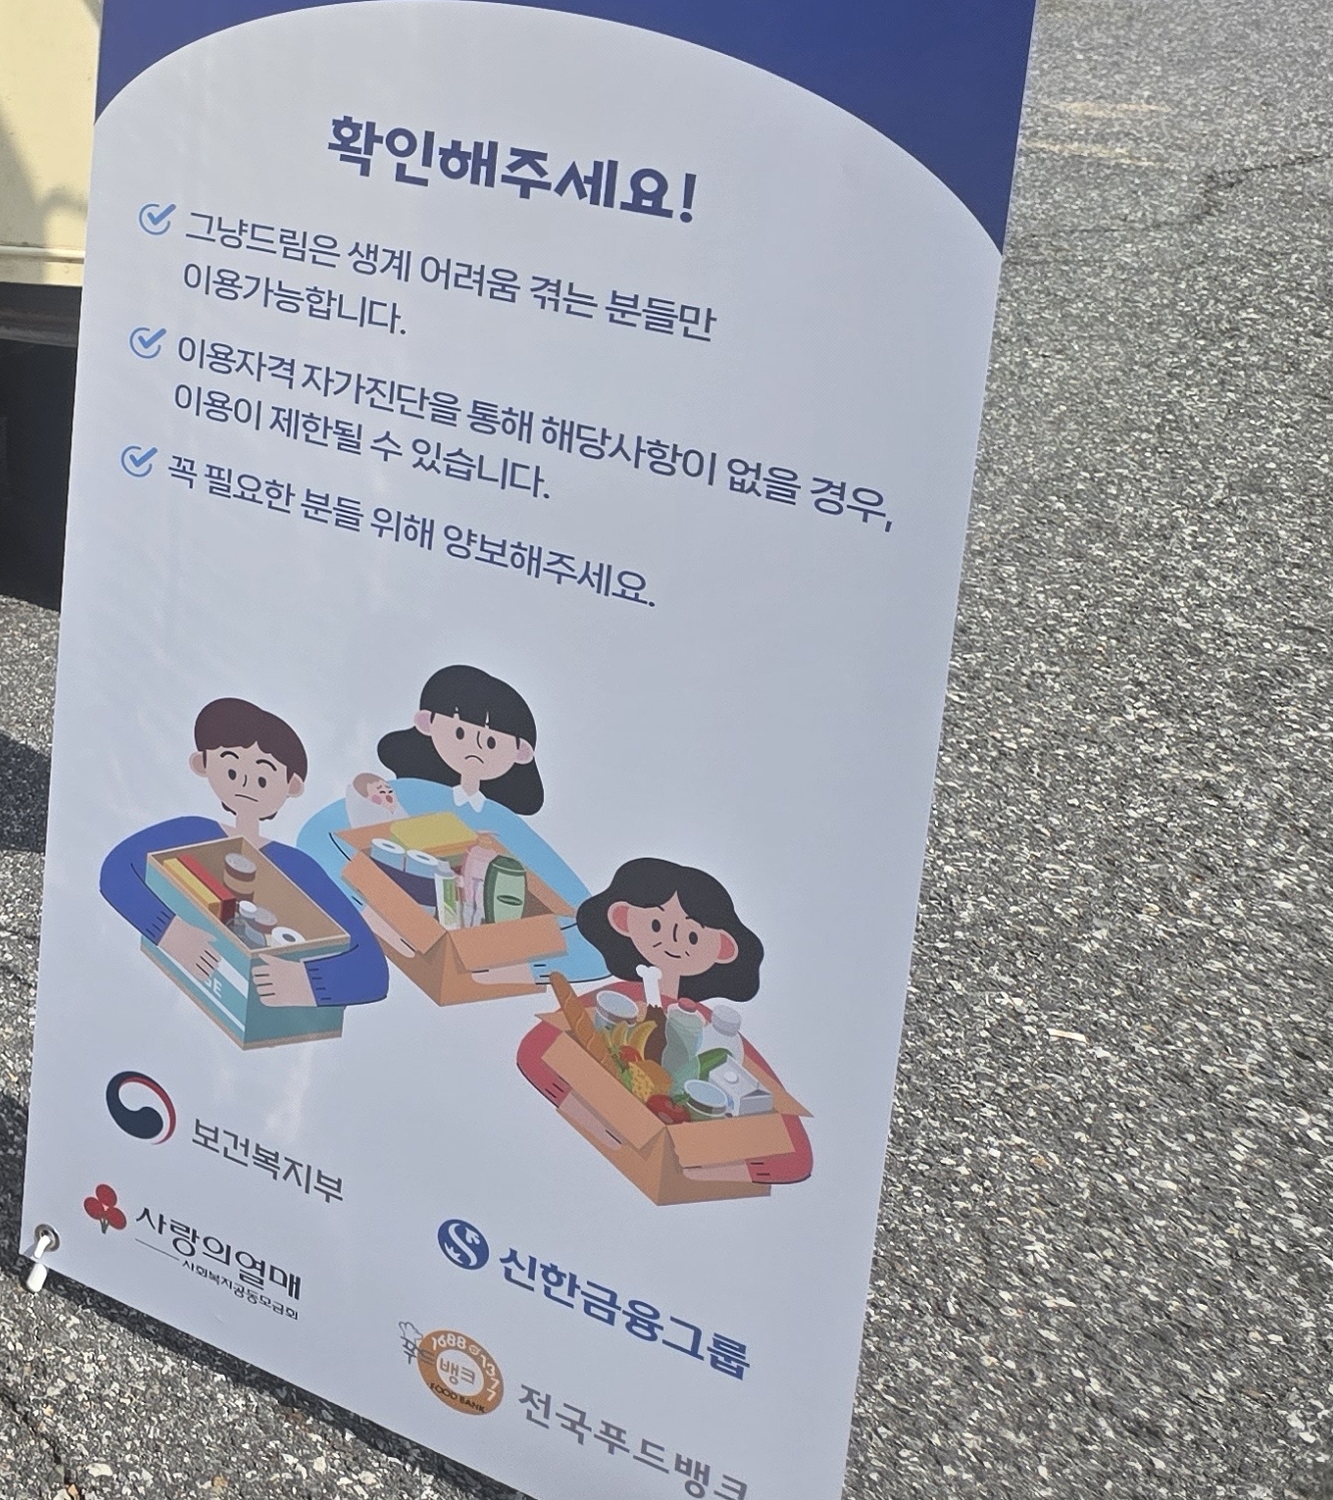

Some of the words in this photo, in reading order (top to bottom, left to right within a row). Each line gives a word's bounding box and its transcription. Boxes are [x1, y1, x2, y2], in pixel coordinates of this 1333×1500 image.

[326, 114, 697, 223] 확인해주세요!
[183, 262, 407, 336] 이용가능합니다.
[185, 211, 341, 269] 그냥드림은
[347, 241, 412, 283] 생계
[420, 255, 521, 304] 어려움
[529, 275, 598, 319] 겪는
[604, 289, 717, 342] 분들만
[174, 383, 262, 431] 이용이
[268, 405, 363, 456] 제한될
[369, 430, 403, 462] 수
[411, 437, 550, 499] 있습니다.
[177, 336, 296, 390] 이용자격
[301, 363, 462, 428] 자가진단을
[466, 399, 534, 444] 통해
[541, 415, 717, 486] 해당사항이
[727, 457, 802, 506] 없을
[809, 476, 893, 533] 경우,
[167, 454, 198, 489] 꼭
[203, 463, 296, 514] 필요한
[300, 488, 364, 533] 분들
[370, 506, 435, 551] 위해
[443, 524, 656, 608] 양보해주세요.
[191, 1117, 344, 1204] 보건복지부
[135, 1206, 302, 1301] 사랑의열매
[181, 1260, 299, 1321] 사회복지공동모금회
[431, 1332, 467, 1351] 1688
[498, 1247, 751, 1381] 신한금융그룹
[439, 1357, 476, 1385] 뱅크
[458, 1395, 486, 1414] BANK
[517, 1383, 748, 1500] 전국푸드뱅크
